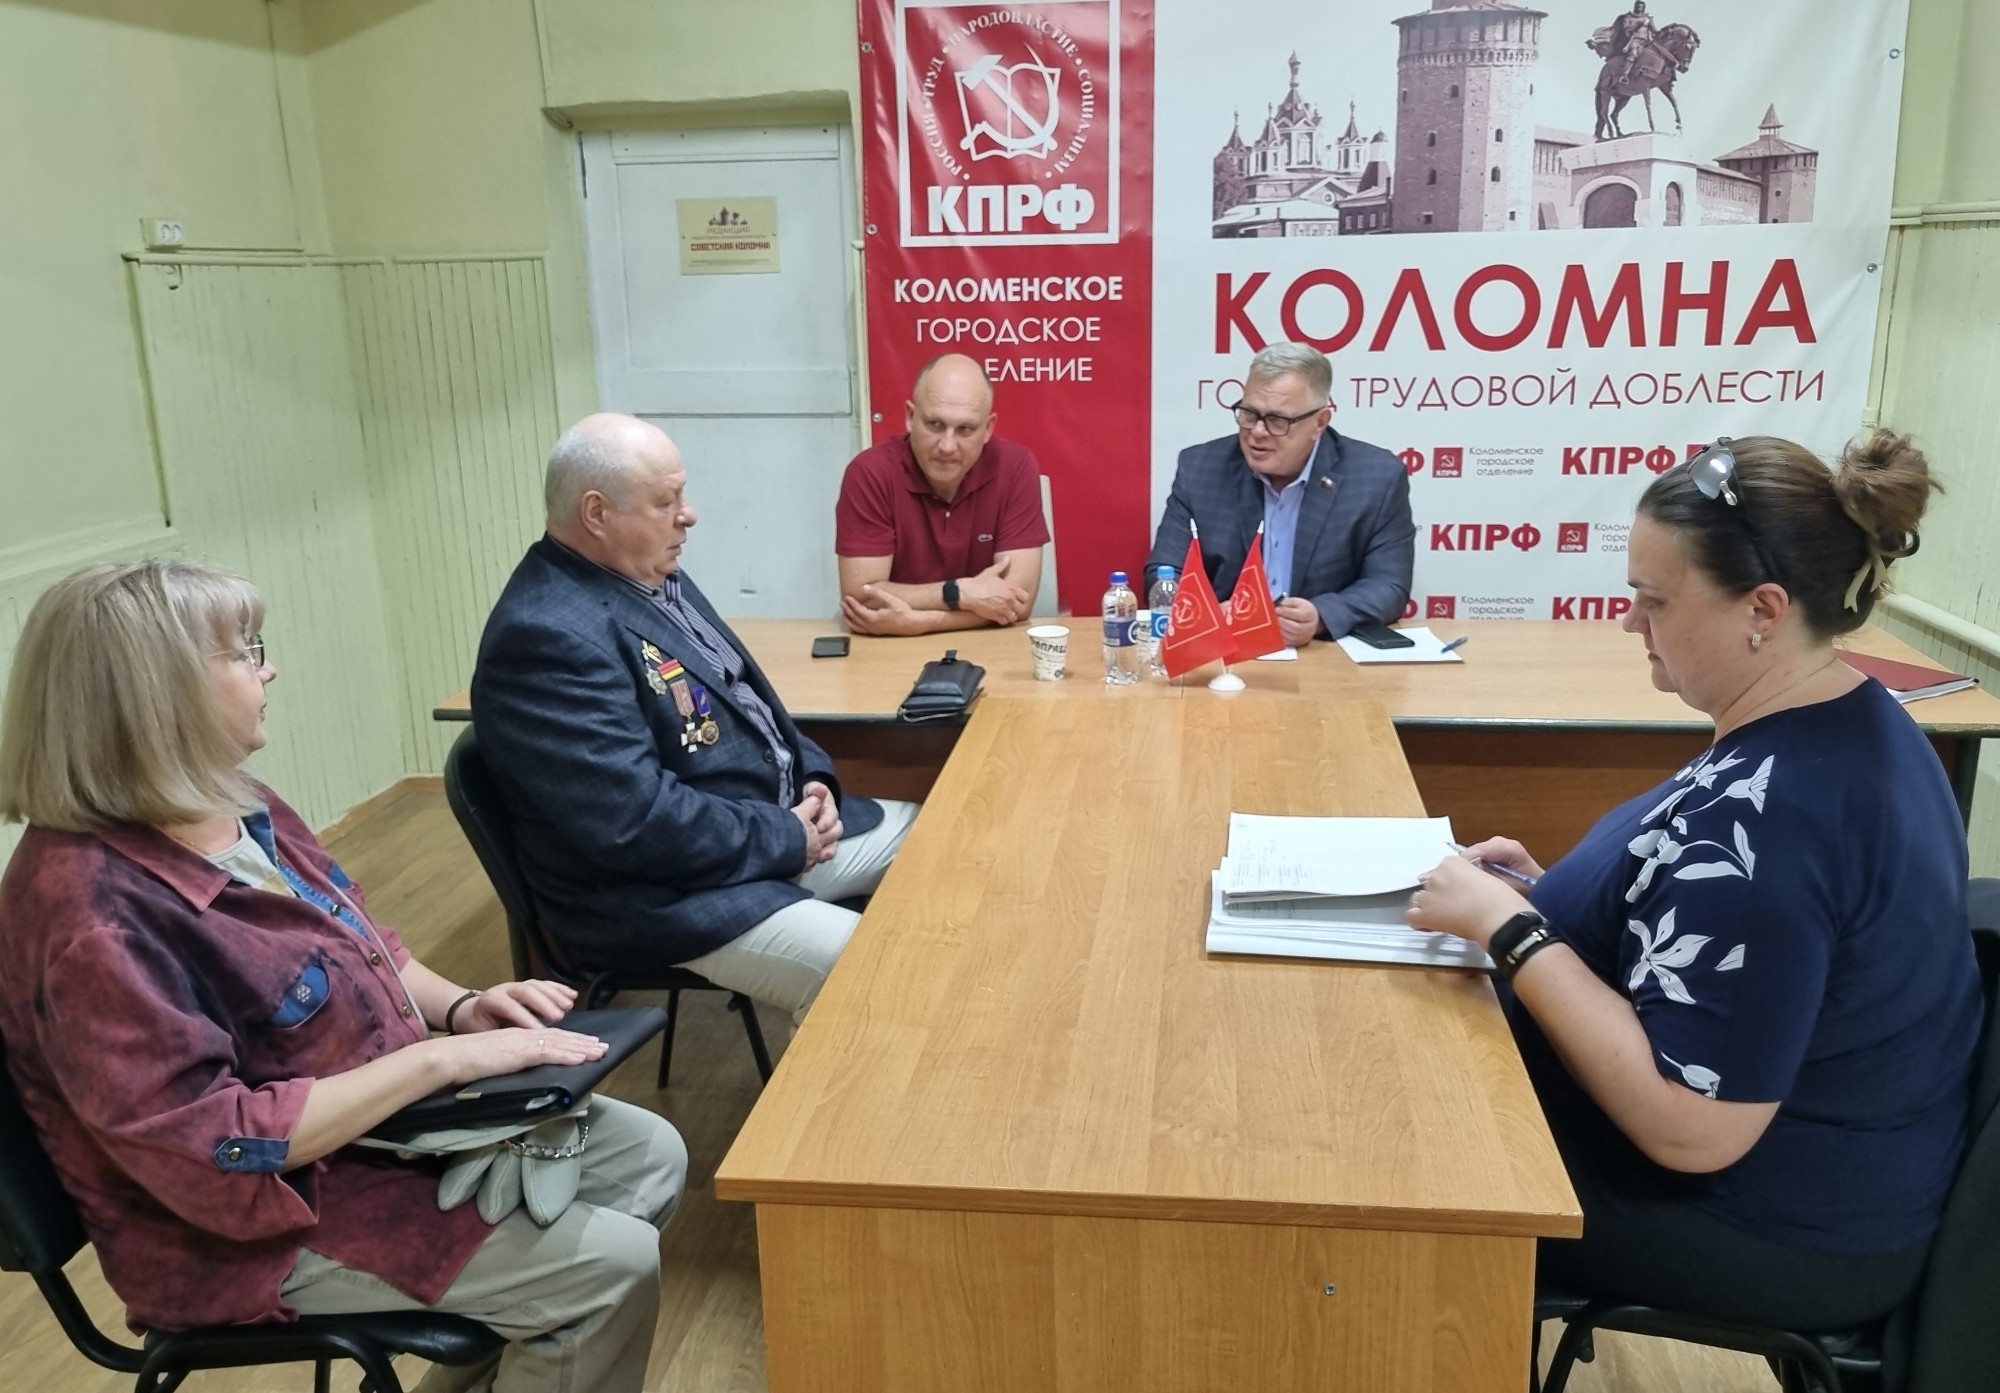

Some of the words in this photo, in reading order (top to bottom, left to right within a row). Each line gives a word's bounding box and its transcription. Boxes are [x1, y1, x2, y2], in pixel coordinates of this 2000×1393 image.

[948, 9, 1079, 59] НАРОДОВЛАСТИЕ
[922, 56, 945, 101] ТРУД
[1053, 68, 1095, 175] СОЦИАЛИЗМ
[923, 115, 963, 177] РОССИЯ
[926, 183, 1095, 233] КПРФ
[735, 241, 771, 251] КОЛОМНА
[893, 275, 1124, 304] КОЛОМЕНСКОЕ
[1214, 258, 1817, 354] КОЛОМНА
[916, 316, 1102, 346] ГОРОДСКОЕ
[984, 356, 1093, 382] ЕЛЕНИЕ
[1350, 367, 1577, 411] ТРУДОВОЙ
[1589, 369, 1825, 409] ДОБЛЕСТИ
[1468, 446, 1545, 456] Коломенское
[1476, 458, 1535, 467] городское
[1561, 445, 1677, 475] КПРФ
[1476, 468, 1534, 477] отделение
[1430, 522, 1542, 552] КПРФ
[1460, 595, 1535, 604] Коломенское
[1468, 606, 1526, 615] городское
[1552, 596, 1632, 620] КПР
